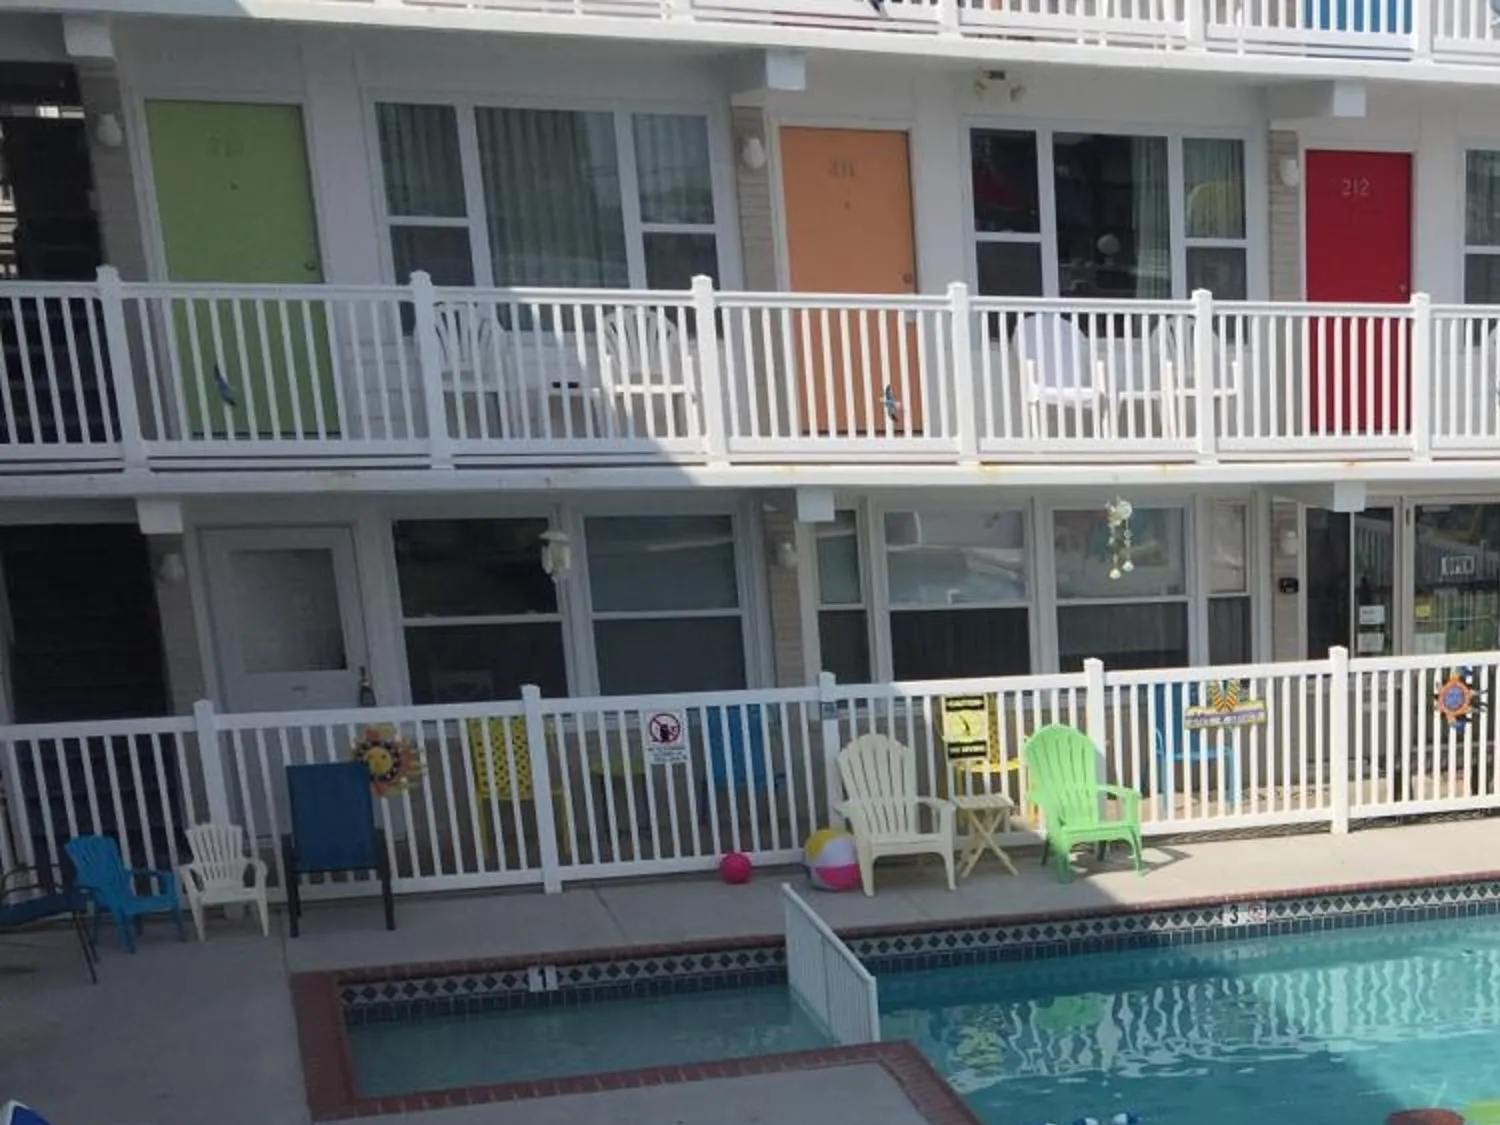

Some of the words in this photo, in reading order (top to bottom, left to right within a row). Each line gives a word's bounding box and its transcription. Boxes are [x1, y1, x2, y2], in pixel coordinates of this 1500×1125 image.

[1341, 177, 1370, 196] 212
[1230, 904, 1239, 924] 3
[538, 968, 547, 988] 1
